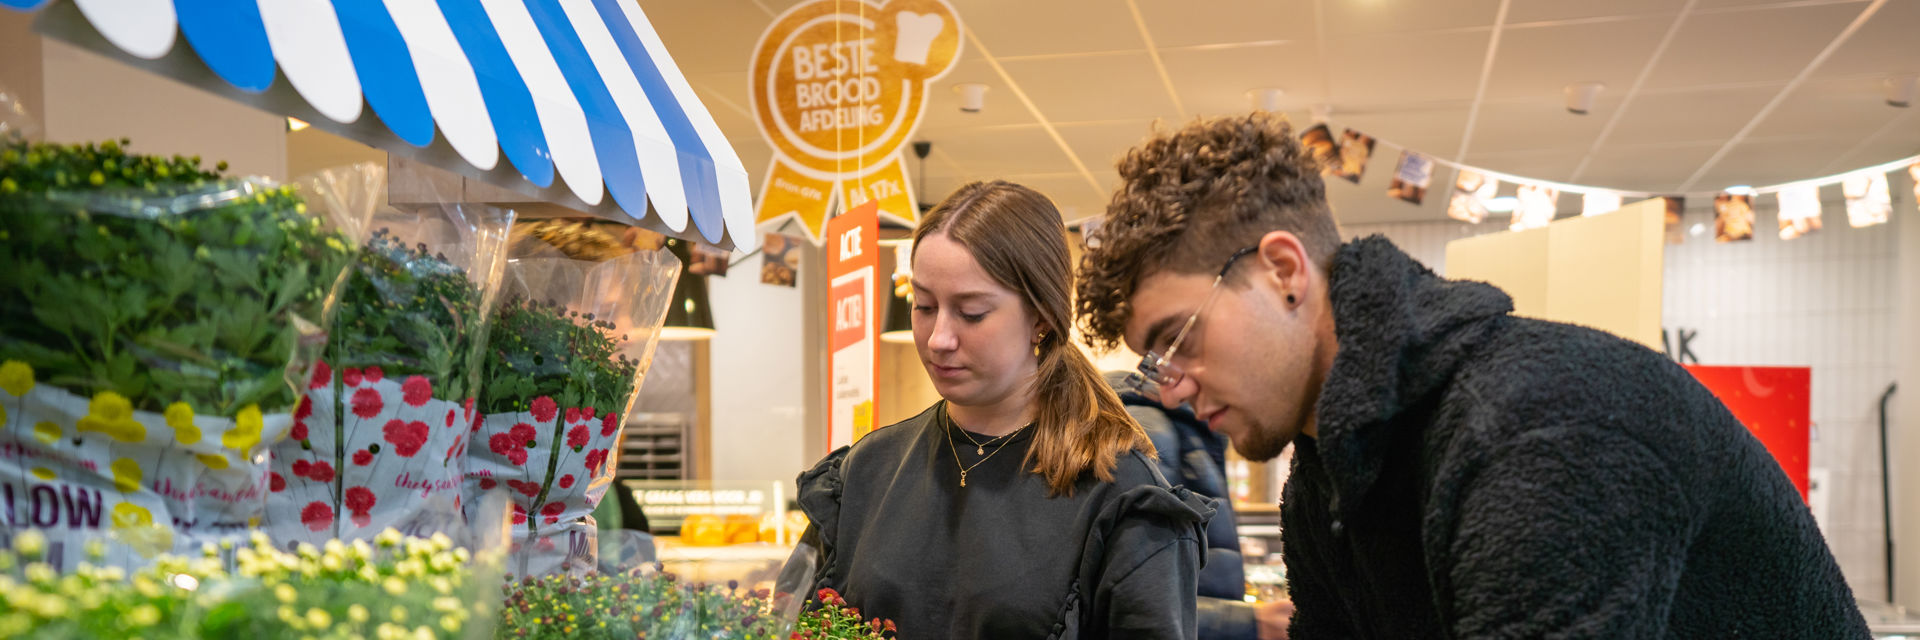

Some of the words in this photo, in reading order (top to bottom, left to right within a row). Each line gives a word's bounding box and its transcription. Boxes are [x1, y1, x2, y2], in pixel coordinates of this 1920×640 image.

[792, 38, 879, 81] BESTE
[795, 76, 881, 110] BROOD
[800, 104, 884, 132] AFDELING
